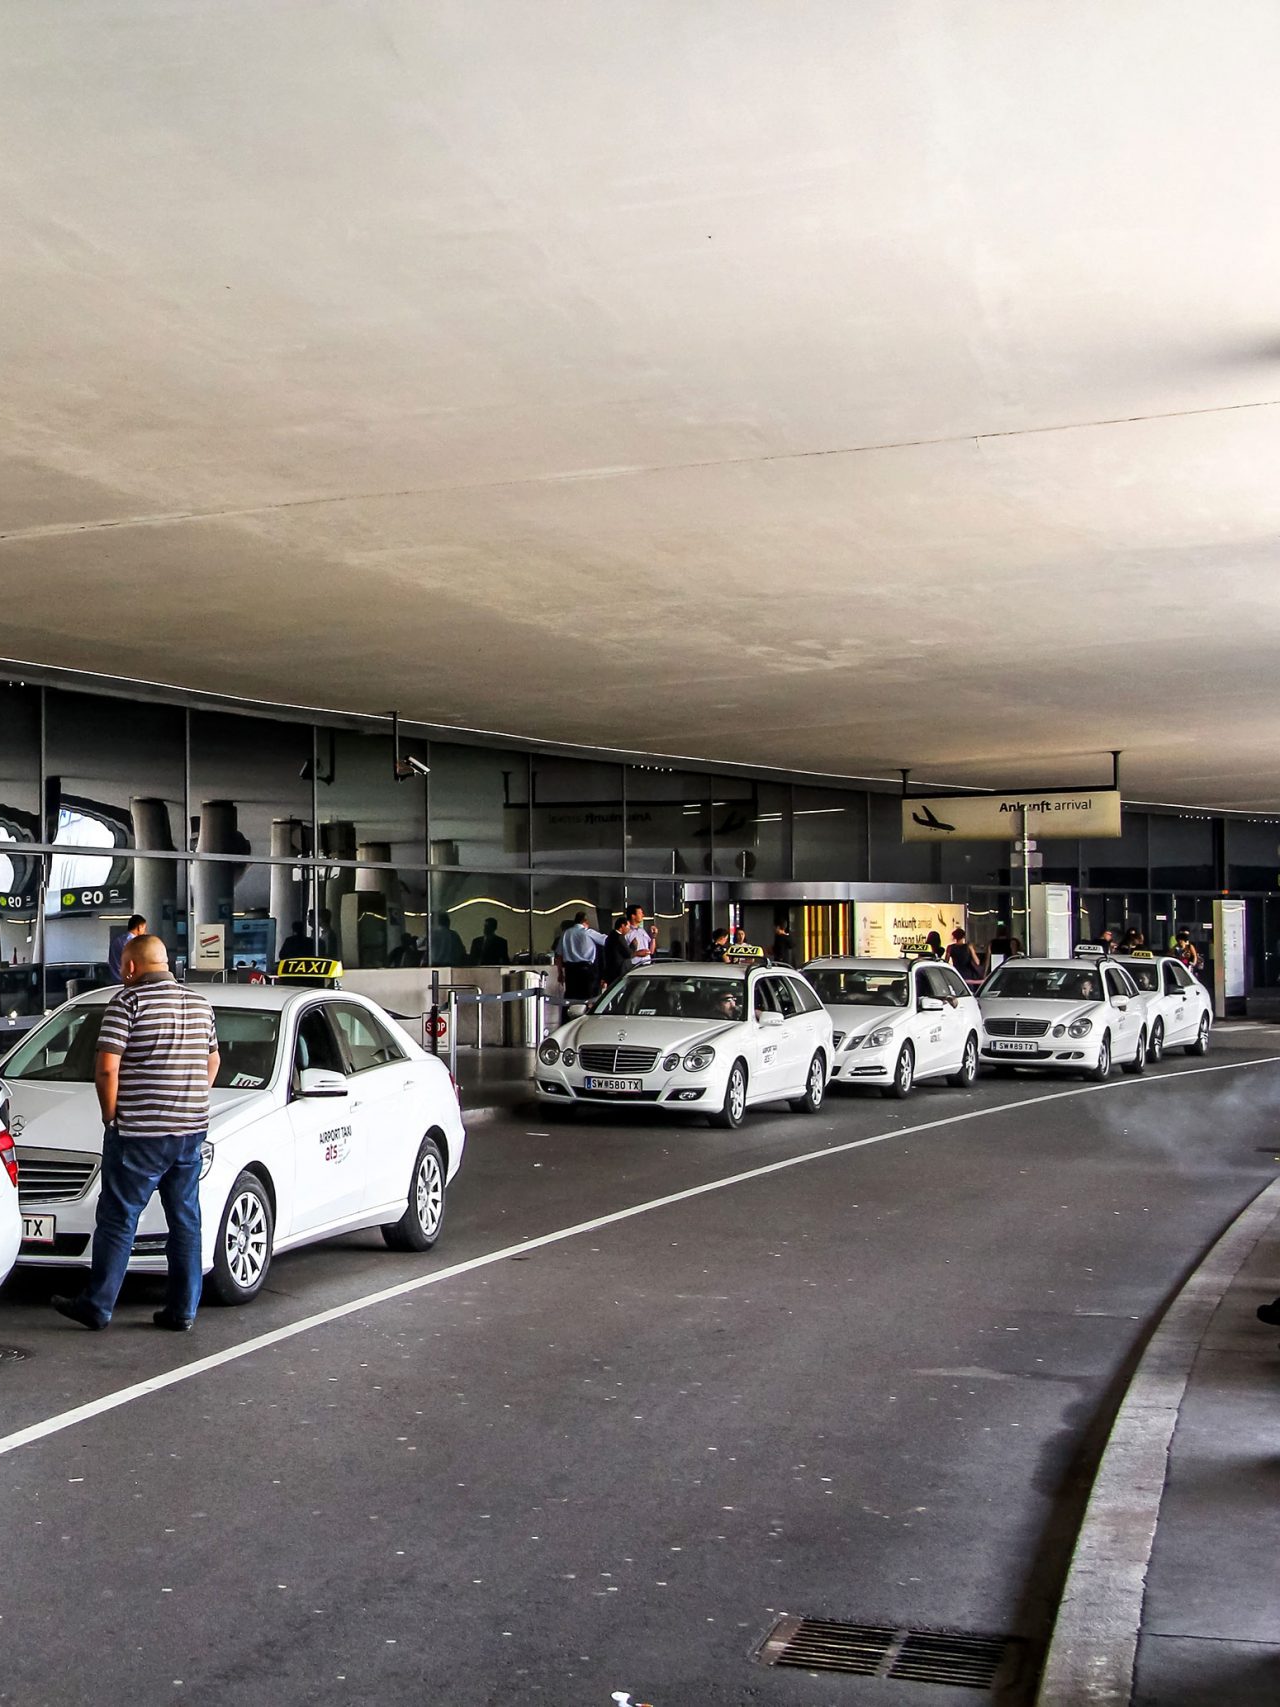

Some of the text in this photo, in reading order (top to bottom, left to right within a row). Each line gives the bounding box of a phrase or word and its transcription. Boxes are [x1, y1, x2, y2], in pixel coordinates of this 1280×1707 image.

[1000, 799, 1092, 813] Anknft arrival
[893, 917, 917, 930] Ankunft
[733, 946, 758, 954] TAXI
[288, 961, 327, 973] TAXI
[592, 1079, 639, 1090] SW 580 TX
[320, 1125, 352, 1144] AIRPORT TAXI
[325, 1144, 338, 1161] ats
[23, 1219, 43, 1236] TX
